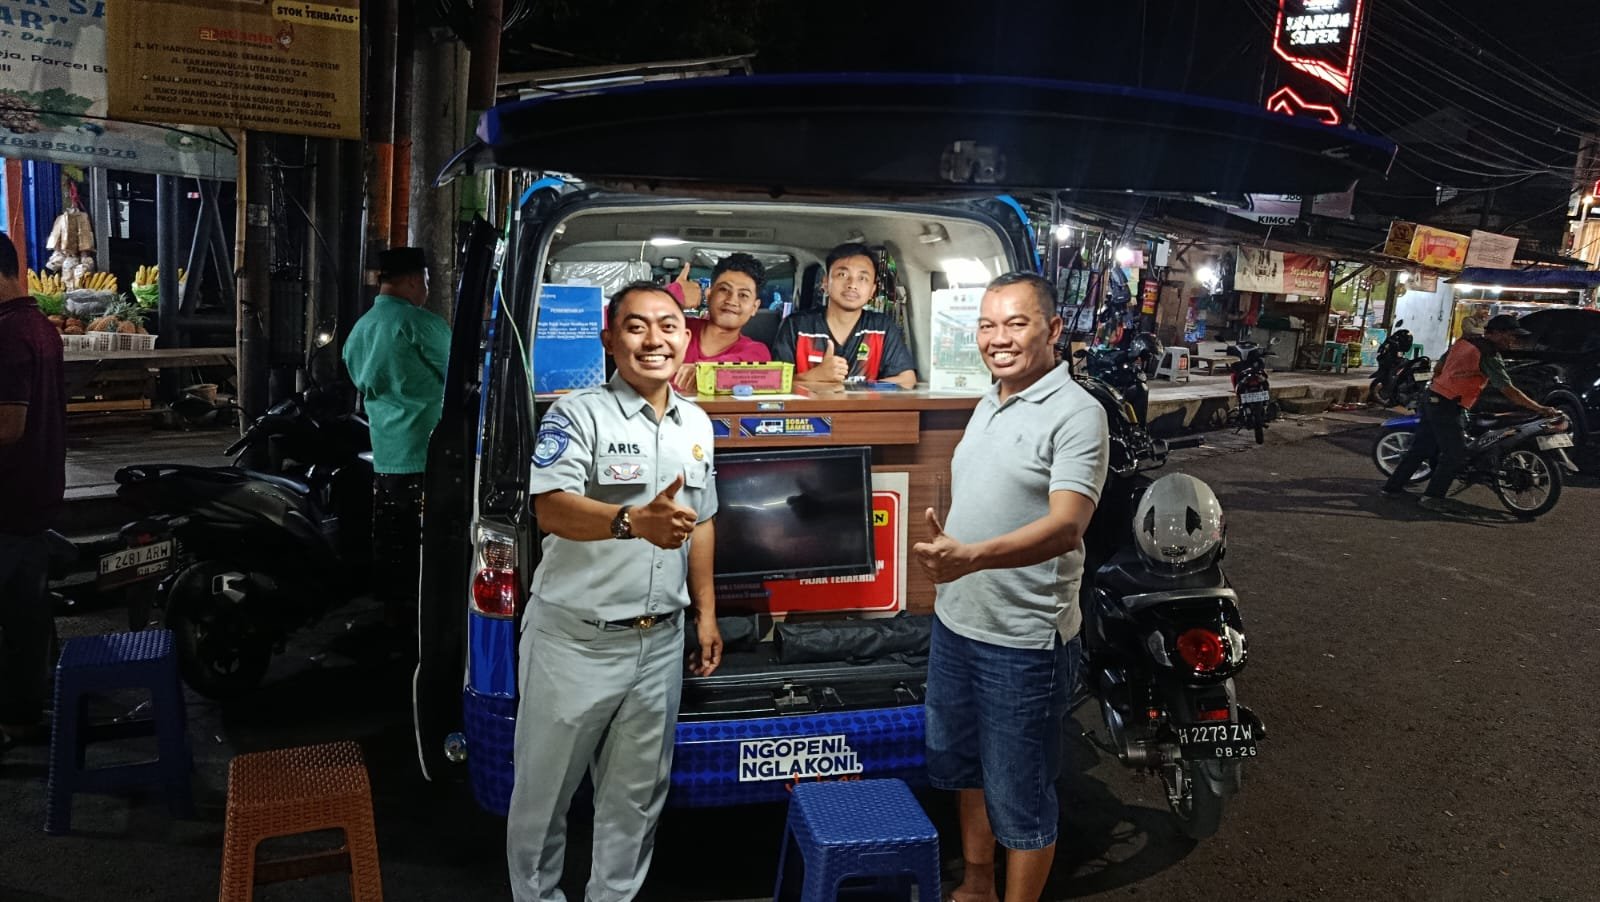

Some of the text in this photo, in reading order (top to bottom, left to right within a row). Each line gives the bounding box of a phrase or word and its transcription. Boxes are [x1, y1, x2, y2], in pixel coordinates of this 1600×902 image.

[277, 6, 355, 24] STOK TERBATAS
[1290, 28, 1340, 46] SUPER
[162, 44, 206, 57] HARYONO
[186, 65, 235, 77] SEMARANG
[249, 64, 278, 75] UTARA
[1257, 215, 1286, 226] KIMO
[607, 442, 641, 455] ARIS
[102, 560, 109, 574] H
[146, 543, 168, 561] ARW
[1178, 724, 1252, 744] H 2273 ZW
[742, 738, 849, 760] NGOPENI.
[742, 754, 862, 778] NGLAKONI.
